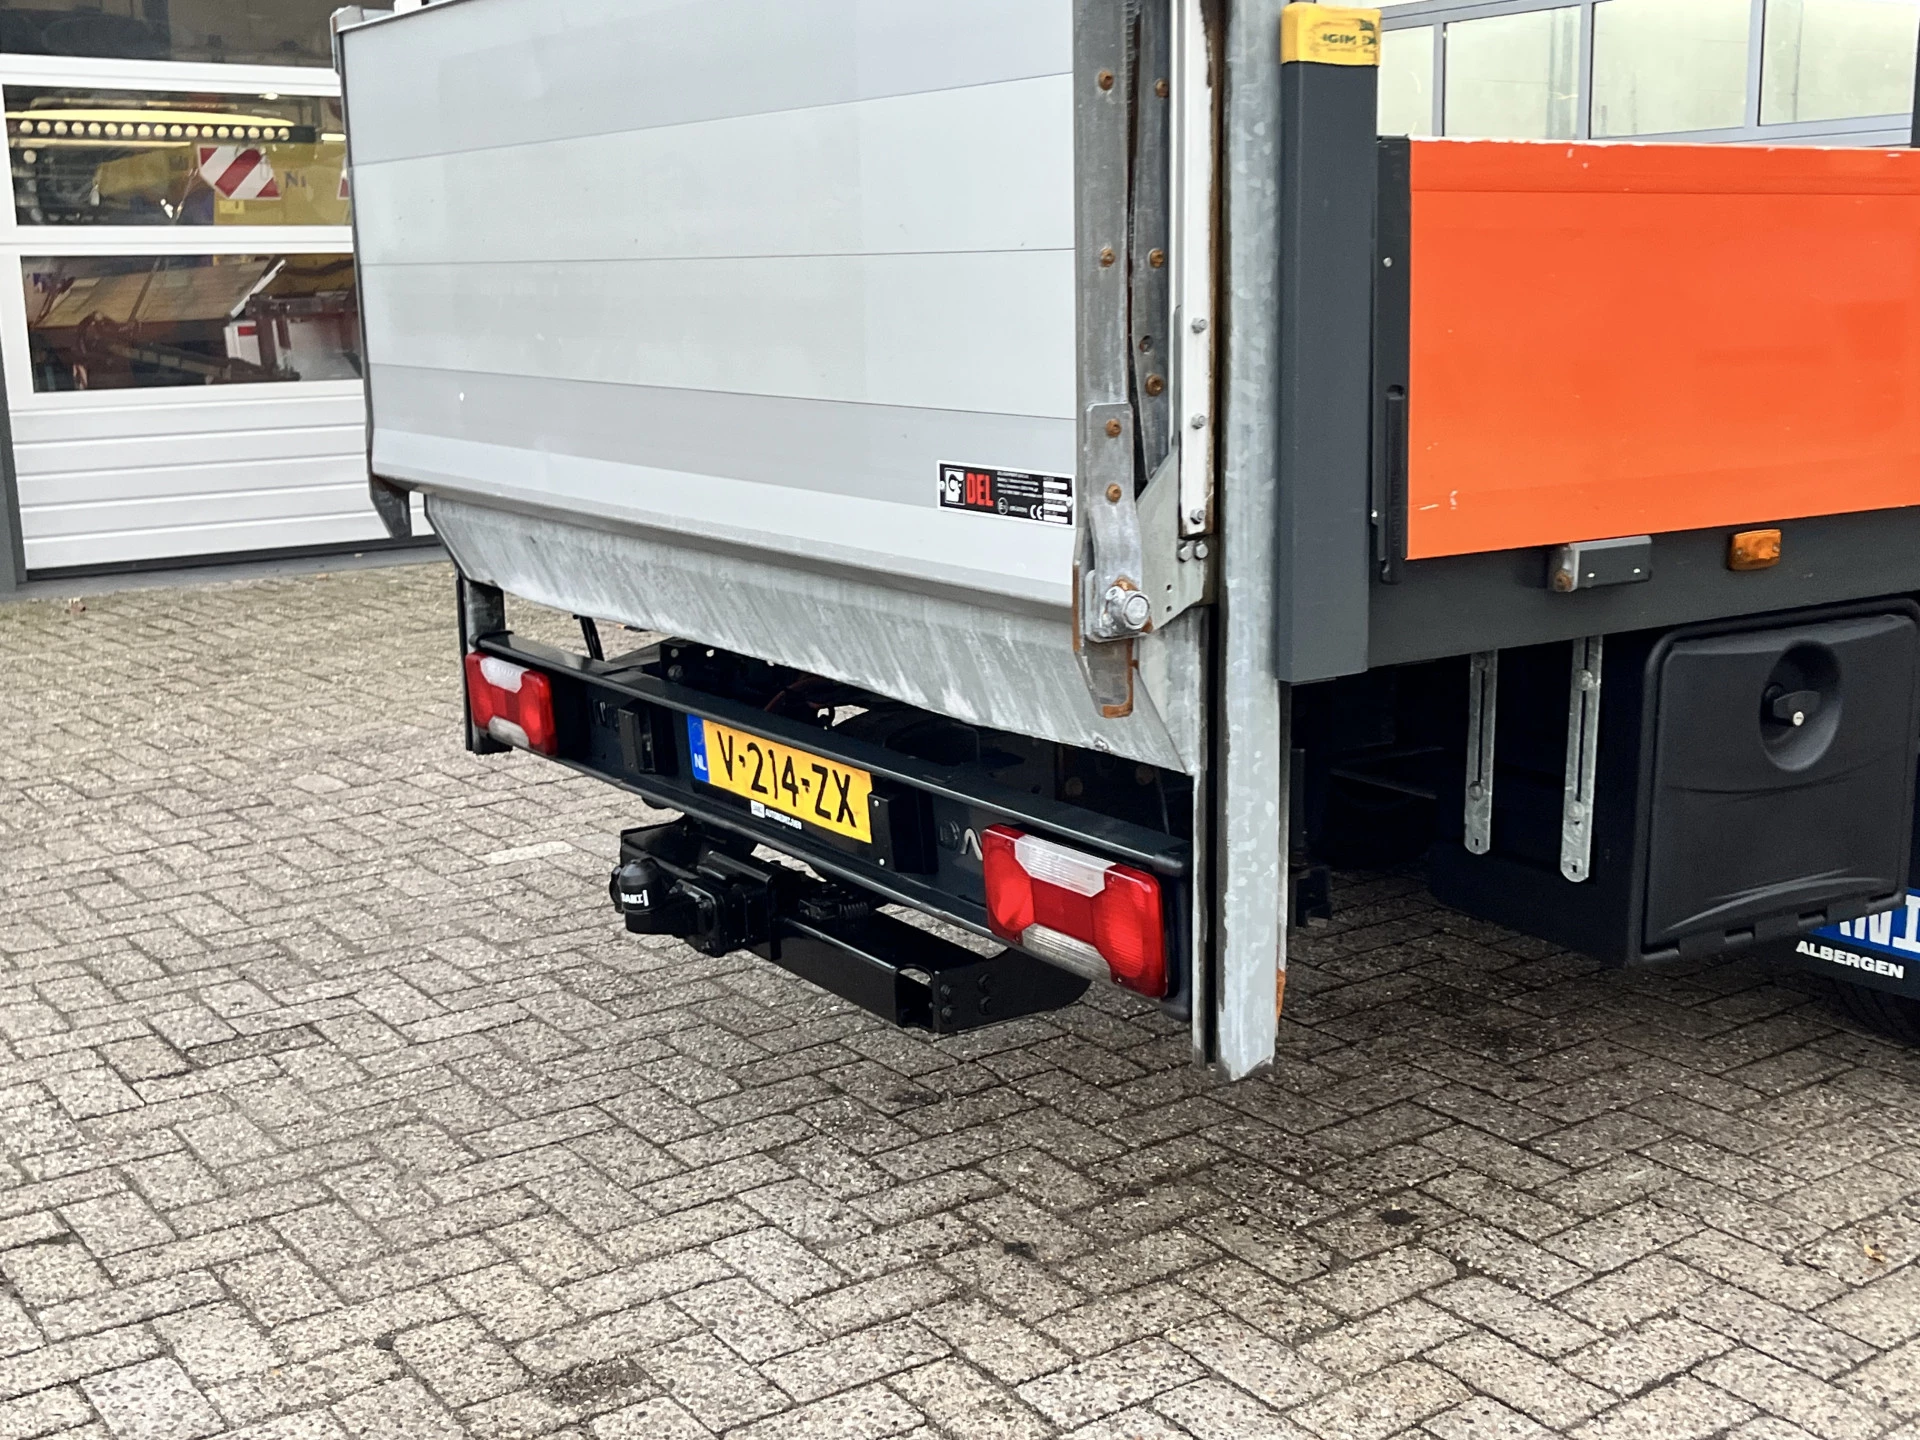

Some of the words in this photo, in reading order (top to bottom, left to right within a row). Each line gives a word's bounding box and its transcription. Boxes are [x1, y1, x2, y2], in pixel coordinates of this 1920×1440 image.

[966, 473, 994, 506] DEL
[694, 752, 707, 771] NL
[1795, 940, 1905, 979] ALBERGEN
